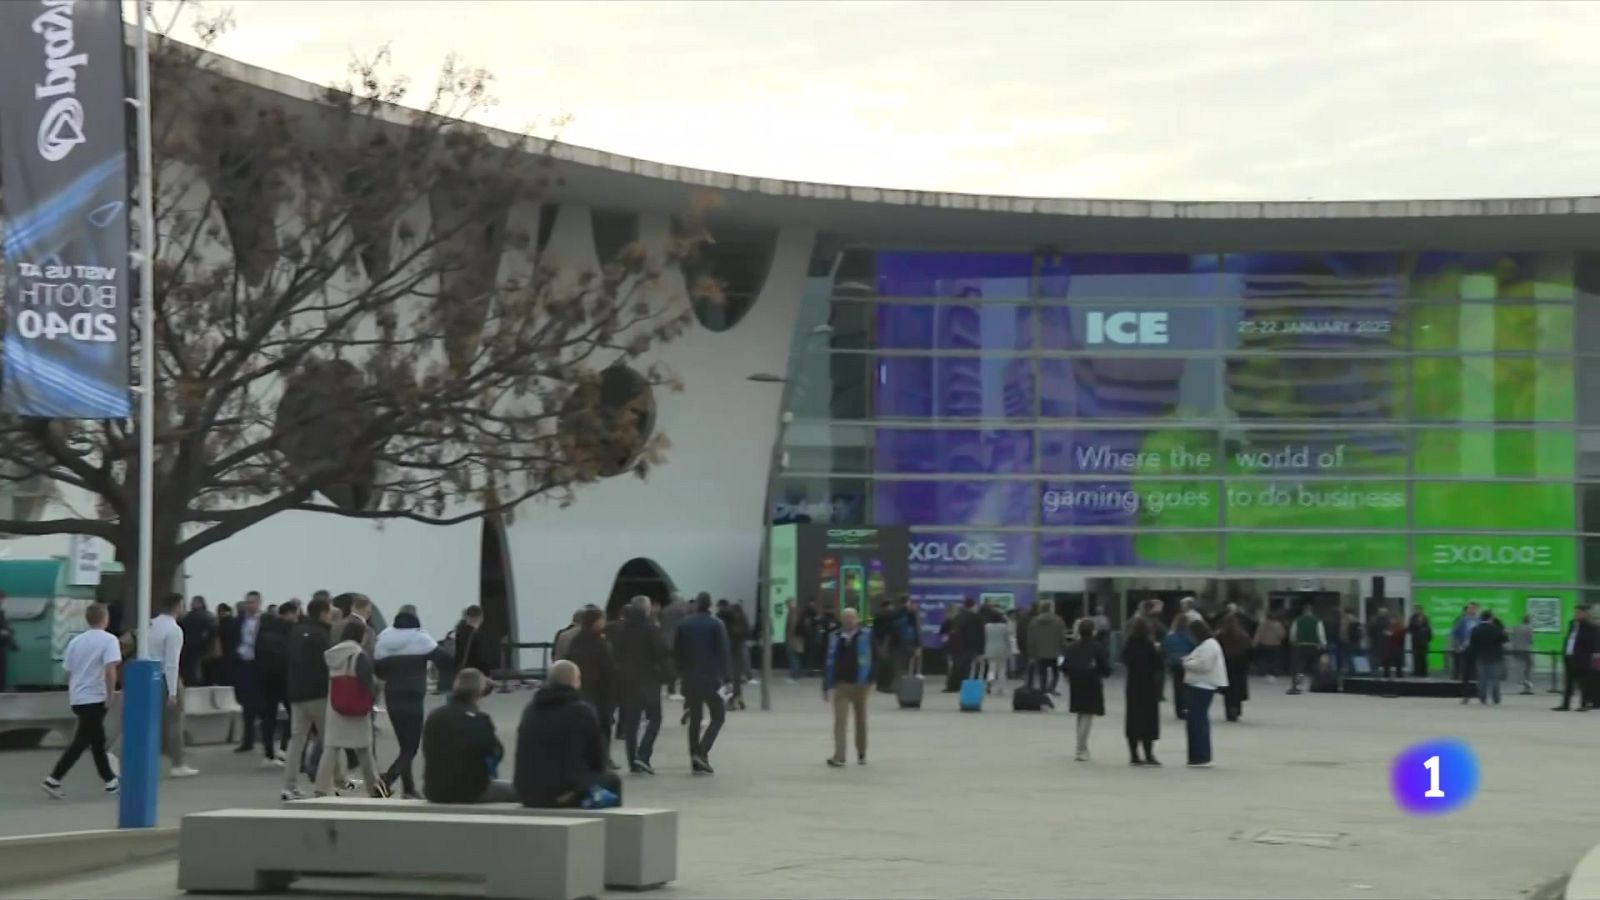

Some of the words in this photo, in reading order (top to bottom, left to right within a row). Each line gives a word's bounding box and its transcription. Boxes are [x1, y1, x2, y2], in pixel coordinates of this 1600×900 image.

[1086, 311, 1169, 344] ICE
[1281, 320, 1350, 334] JANUARY
[1355, 320, 1391, 333] 2025
[1076, 445, 1160, 469] Where
[1169, 445, 1212, 468] the
[1235, 445, 1310, 468] world
[1318, 444, 1345, 468] of
[1043, 485, 1140, 515] gaming
[1148, 490, 1210, 514] goes
[1227, 488, 1252, 507] to
[1258, 483, 1291, 507] do
[1297, 484, 1406, 508] business
[908, 542, 1007, 561] XPLORE
